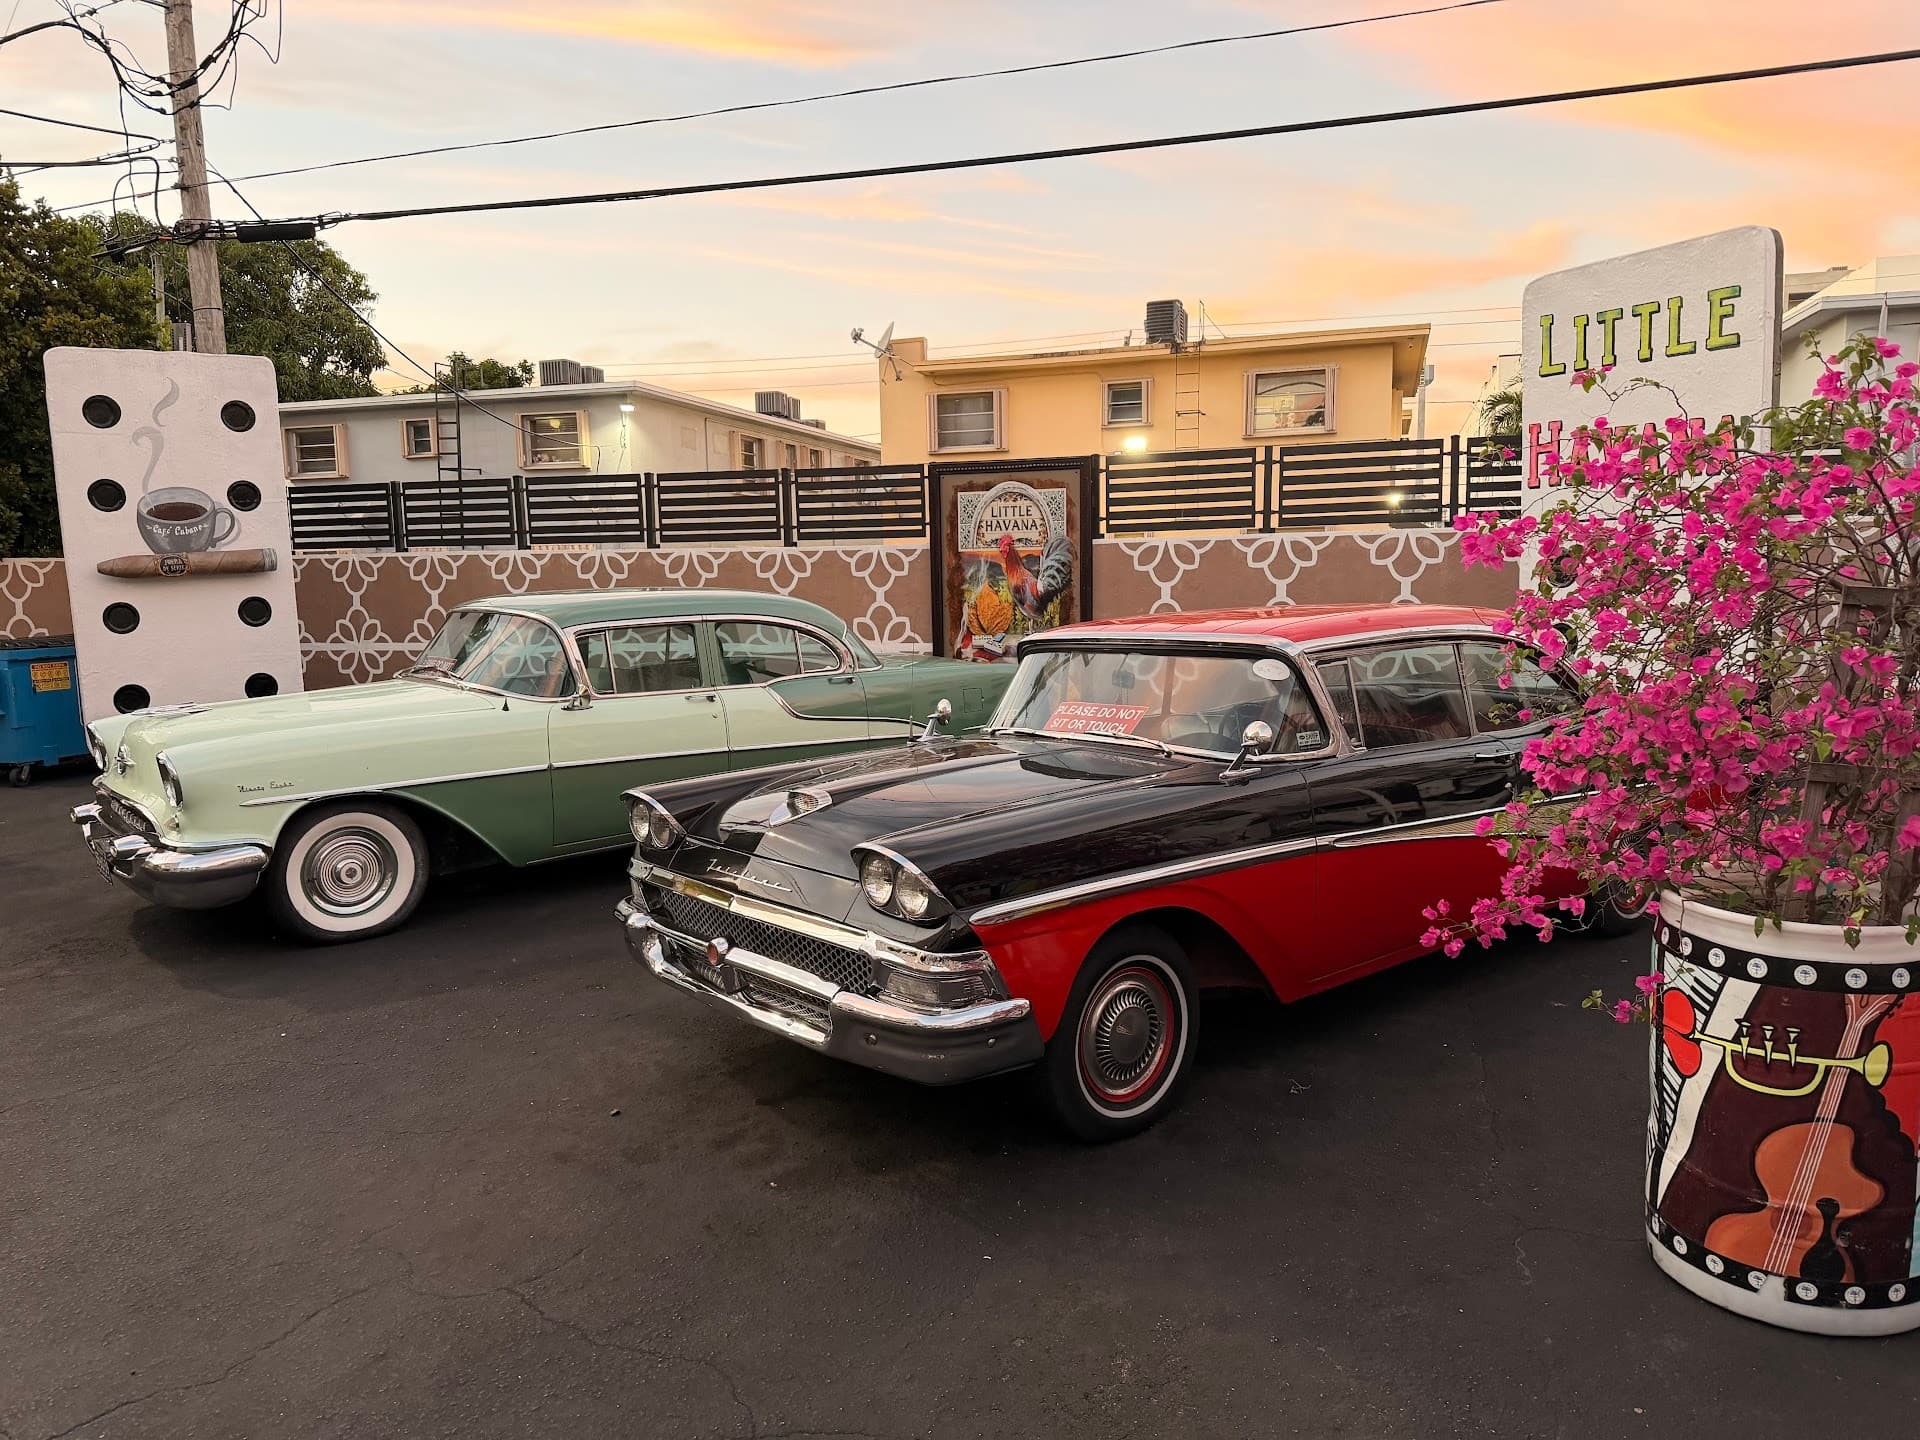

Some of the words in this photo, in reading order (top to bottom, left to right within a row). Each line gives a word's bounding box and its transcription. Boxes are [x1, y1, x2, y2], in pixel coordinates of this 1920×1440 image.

[1539, 285, 1741, 377] LITTLE
[991, 505, 1033, 518] LITTLE
[985, 519, 1039, 532] HAVANA
[1055, 705, 1098, 716] PLEASE
[1099, 707, 1116, 718] DO
[1116, 709, 1144, 721] NOT
[1050, 718, 1069, 728] SIT
[1067, 719, 1085, 730] OR
[1085, 720, 1127, 734] TOUCH
